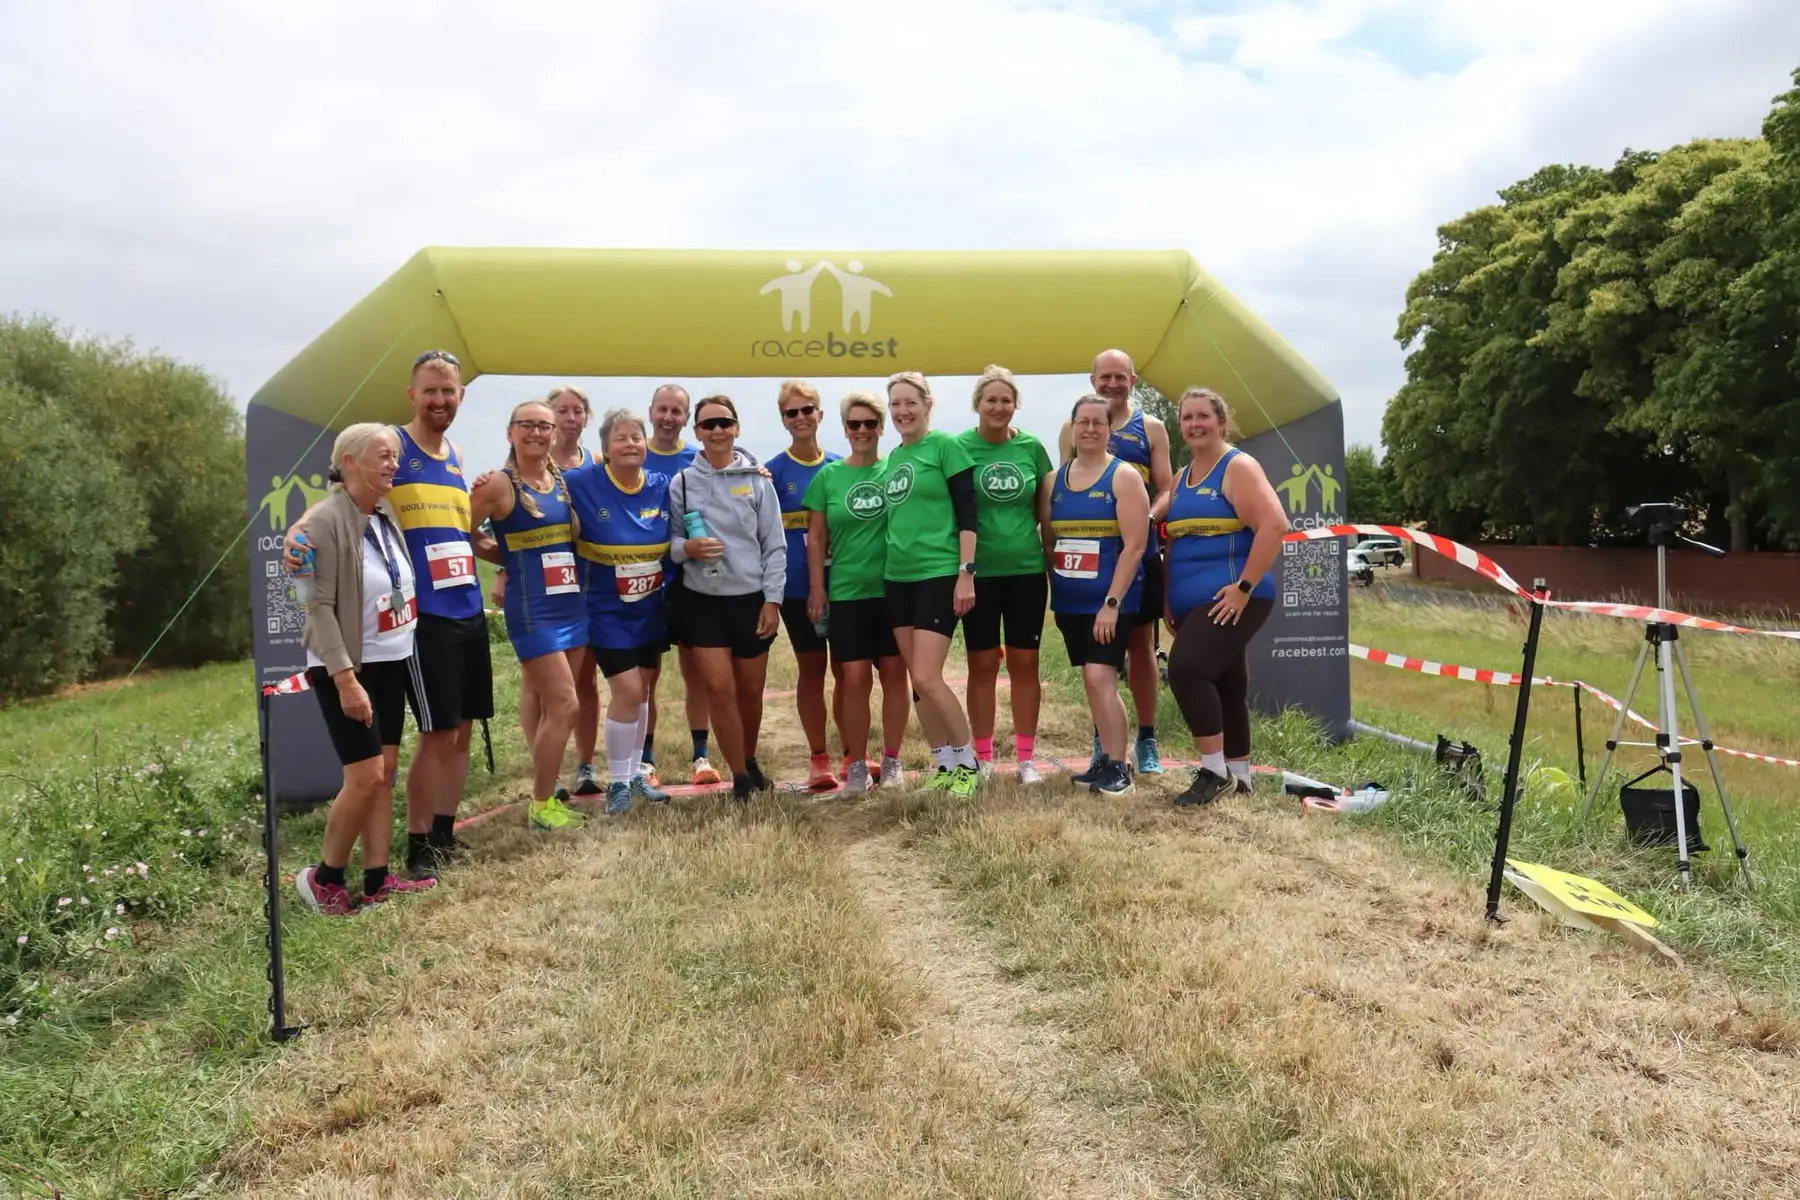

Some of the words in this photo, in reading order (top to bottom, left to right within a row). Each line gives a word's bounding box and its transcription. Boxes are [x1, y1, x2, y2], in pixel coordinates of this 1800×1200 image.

[751, 331, 898, 359] racebest
[400, 502, 426, 513] GOOLE
[447, 557, 468, 577] 57
[1064, 554, 1083, 570] 87
[561, 567, 576, 585] 34
[627, 576, 657, 595] 287
[389, 603, 412, 628] 100
[1272, 646, 1345, 658] racebest.com
